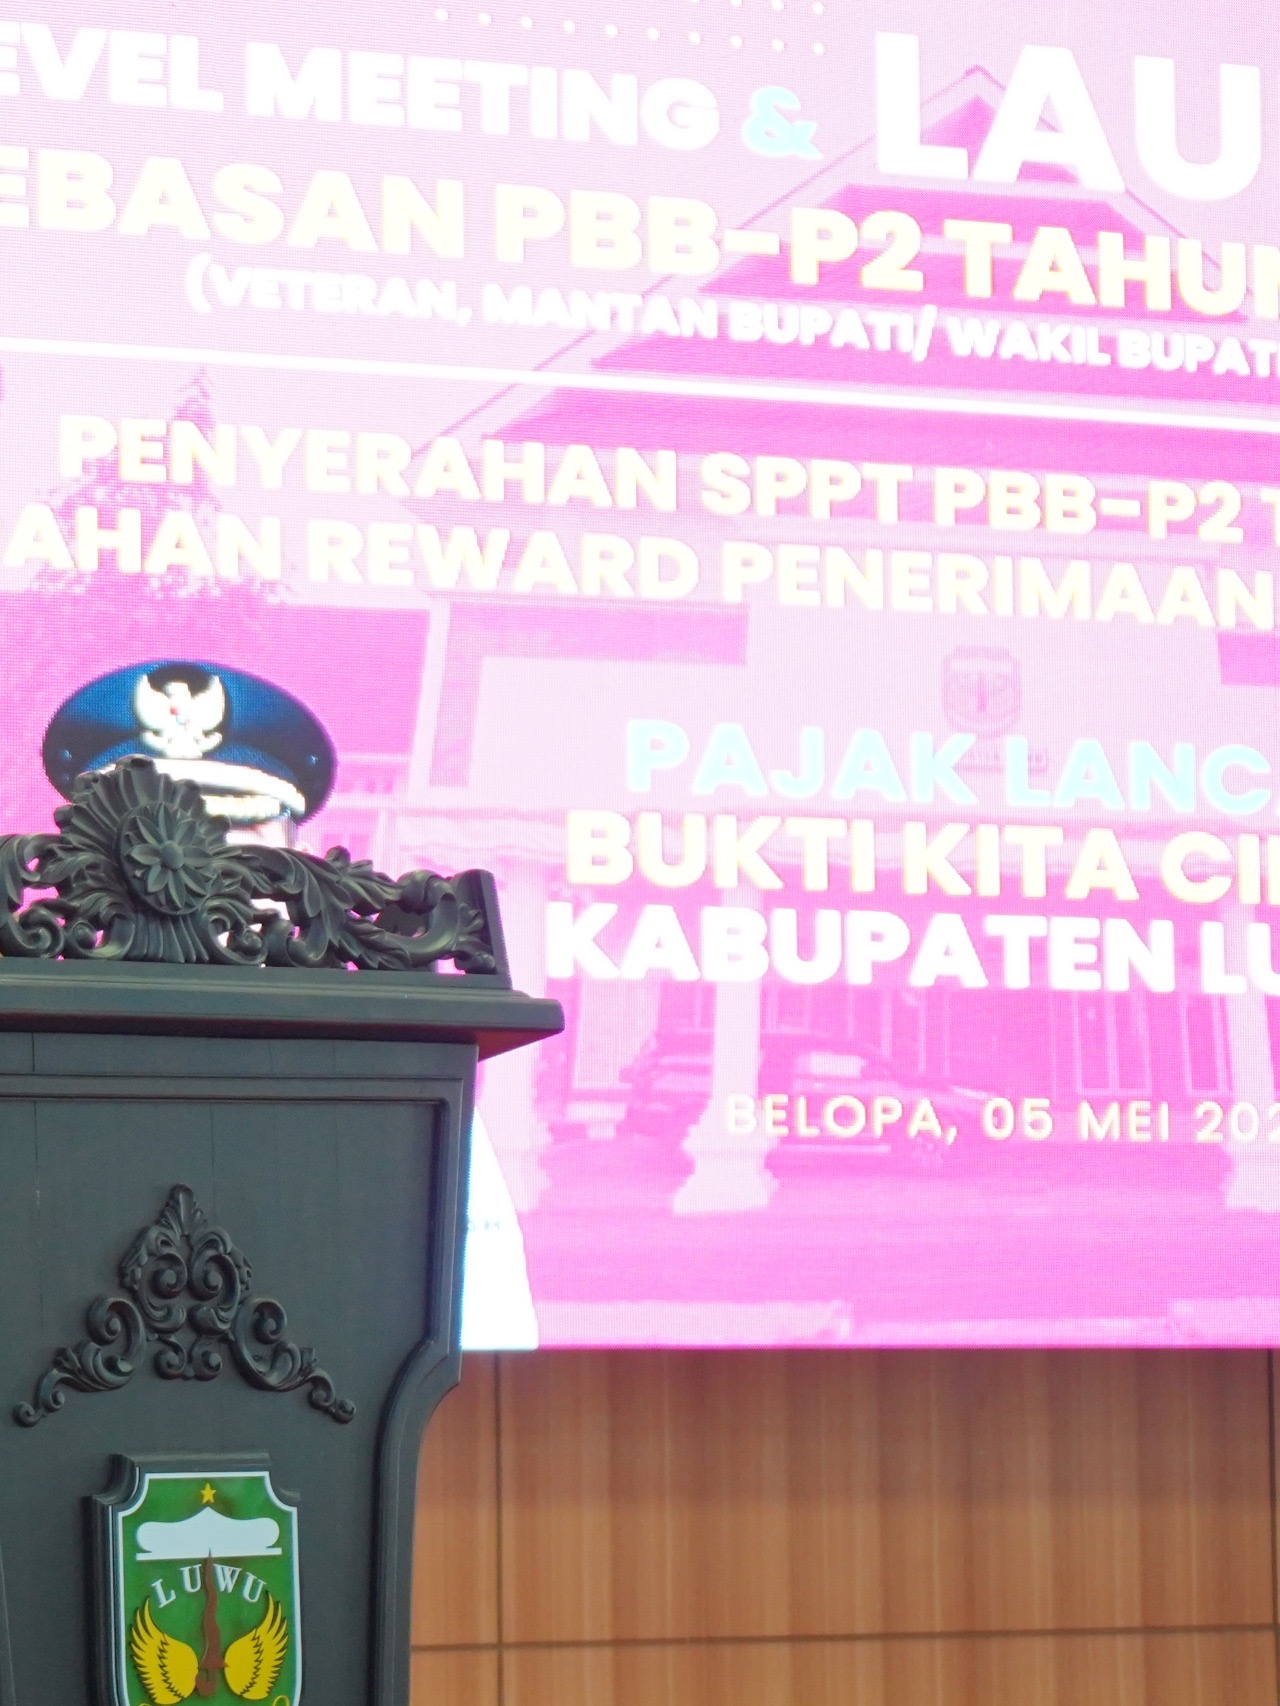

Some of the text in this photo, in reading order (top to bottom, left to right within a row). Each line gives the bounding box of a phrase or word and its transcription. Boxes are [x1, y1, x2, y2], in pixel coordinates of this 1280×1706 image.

[246, 43, 721, 151] MEETING
[743, 86, 824, 160] &
[876, 31, 1262, 200] LAU
[494, 183, 924, 291] PBB-P2
[186, 255, 472, 326] (VETERAN,
[484, 285, 717, 341] MANTAN
[948, 317, 1110, 366] WAKIL
[1122, 327, 1280, 377] BUPAT
[60, 413, 677, 511] PENYERAHAN
[699, 451, 914, 523] SPPT
[934, 467, 1245, 544] PBB-P2
[310, 518, 700, 601] REWARD
[721, 539, 1275, 630] PENERIMAAN
[626, 719, 1280, 816] PAJAK LANC
[567, 811, 1280, 905] BUKTI KITA CI
[545, 902, 1176, 992] KABUPATEN
[727, 1094, 959, 1146] BELOPA,
[983, 1098, 1053, 1139] 05
[1078, 1099, 1169, 1142] MEI
[151, 1564, 267, 1608] LUWU
